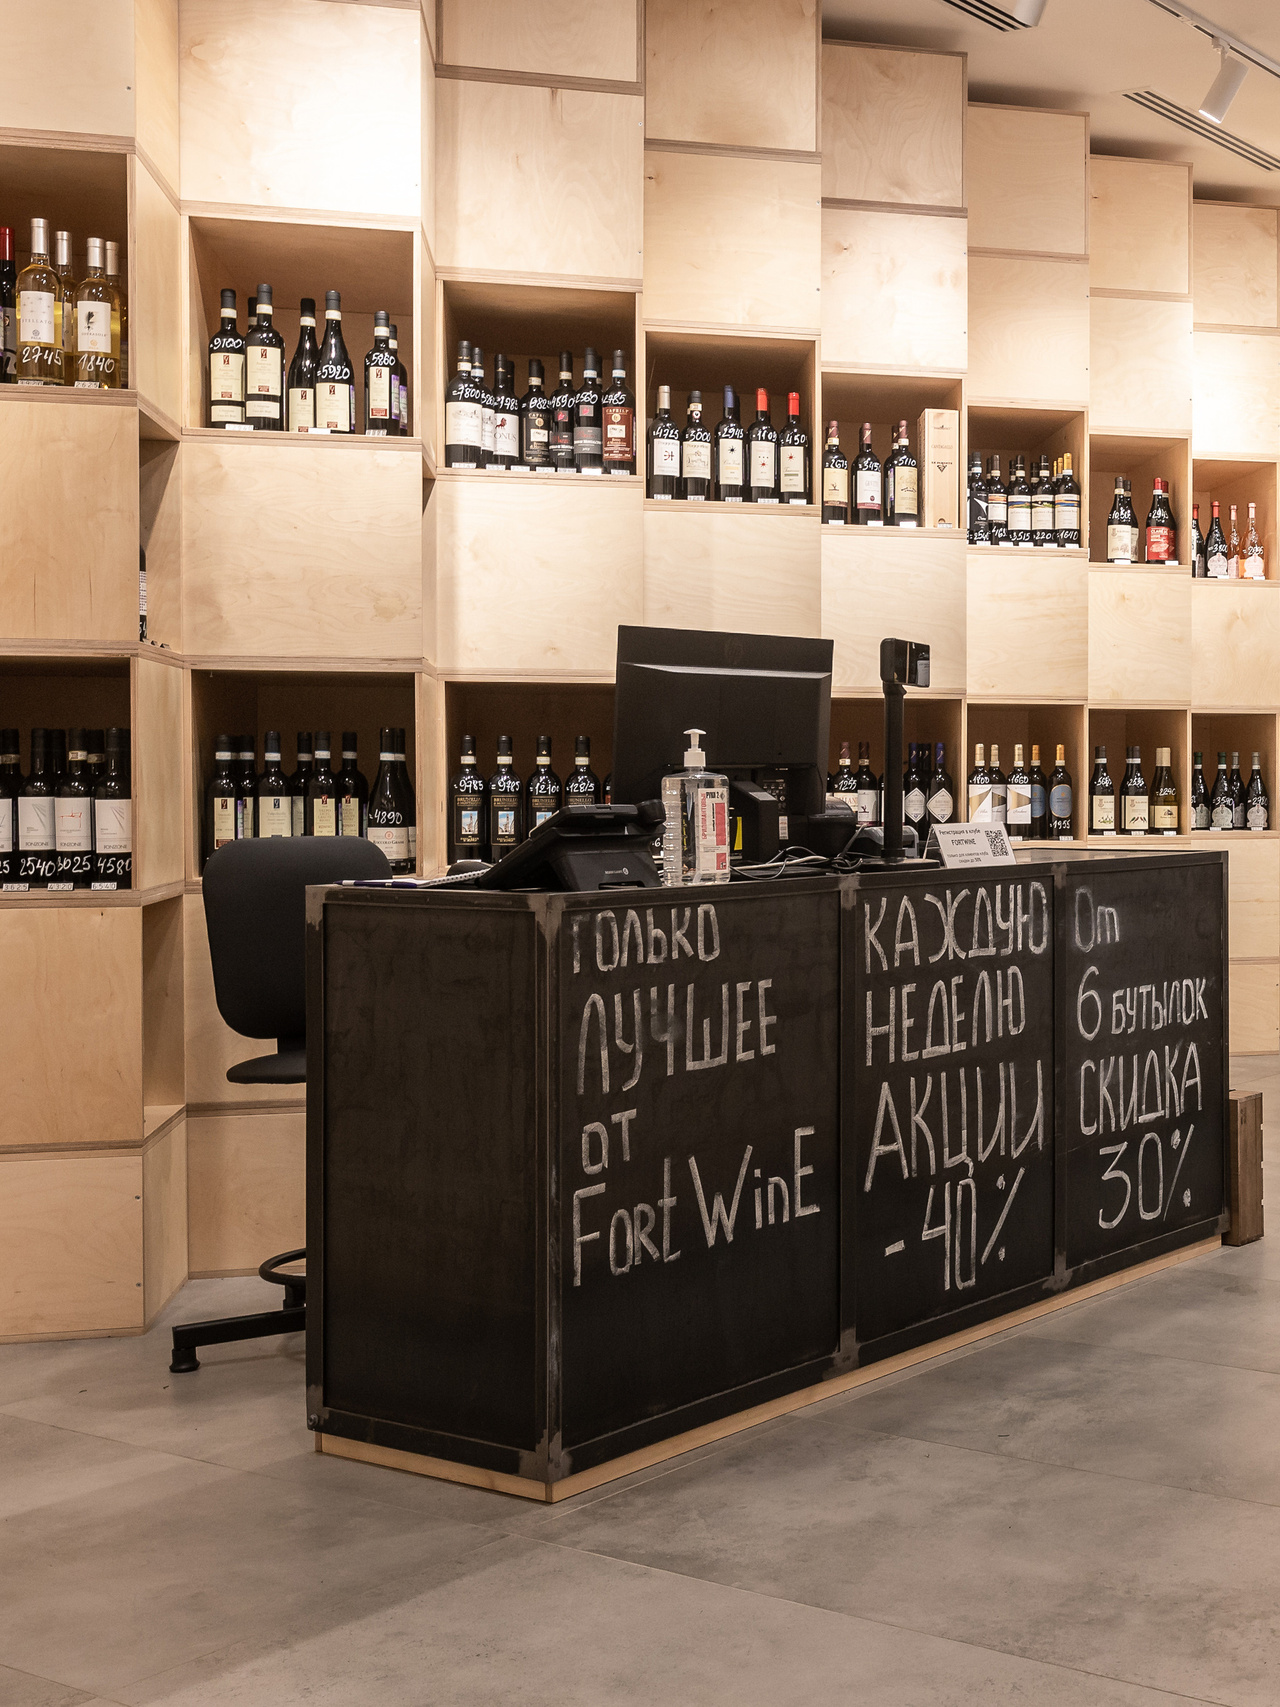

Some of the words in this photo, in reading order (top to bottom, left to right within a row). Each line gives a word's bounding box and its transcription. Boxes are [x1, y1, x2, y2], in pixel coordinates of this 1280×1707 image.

[22, 345, 63, 365] 2745
[78, 353, 115, 373] 1840
[19, 856, 56, 876] 2540
[951, 838, 977, 846] FORTWINE
[571, 904, 721, 974] ТОЛЬКО
[864, 881, 1050, 974] КАЖДУЮ
[575, 978, 777, 1096] ЛУЧШЕЕ
[865, 965, 1026, 1067] НЕДЕЛЮ
[1075, 966, 1103, 1041] 6
[863, 1059, 1044, 1193] АКЦИИ
[1079, 1041, 1204, 1136] СКИДКА
[1099, 1123, 1195, 1230] 30%
